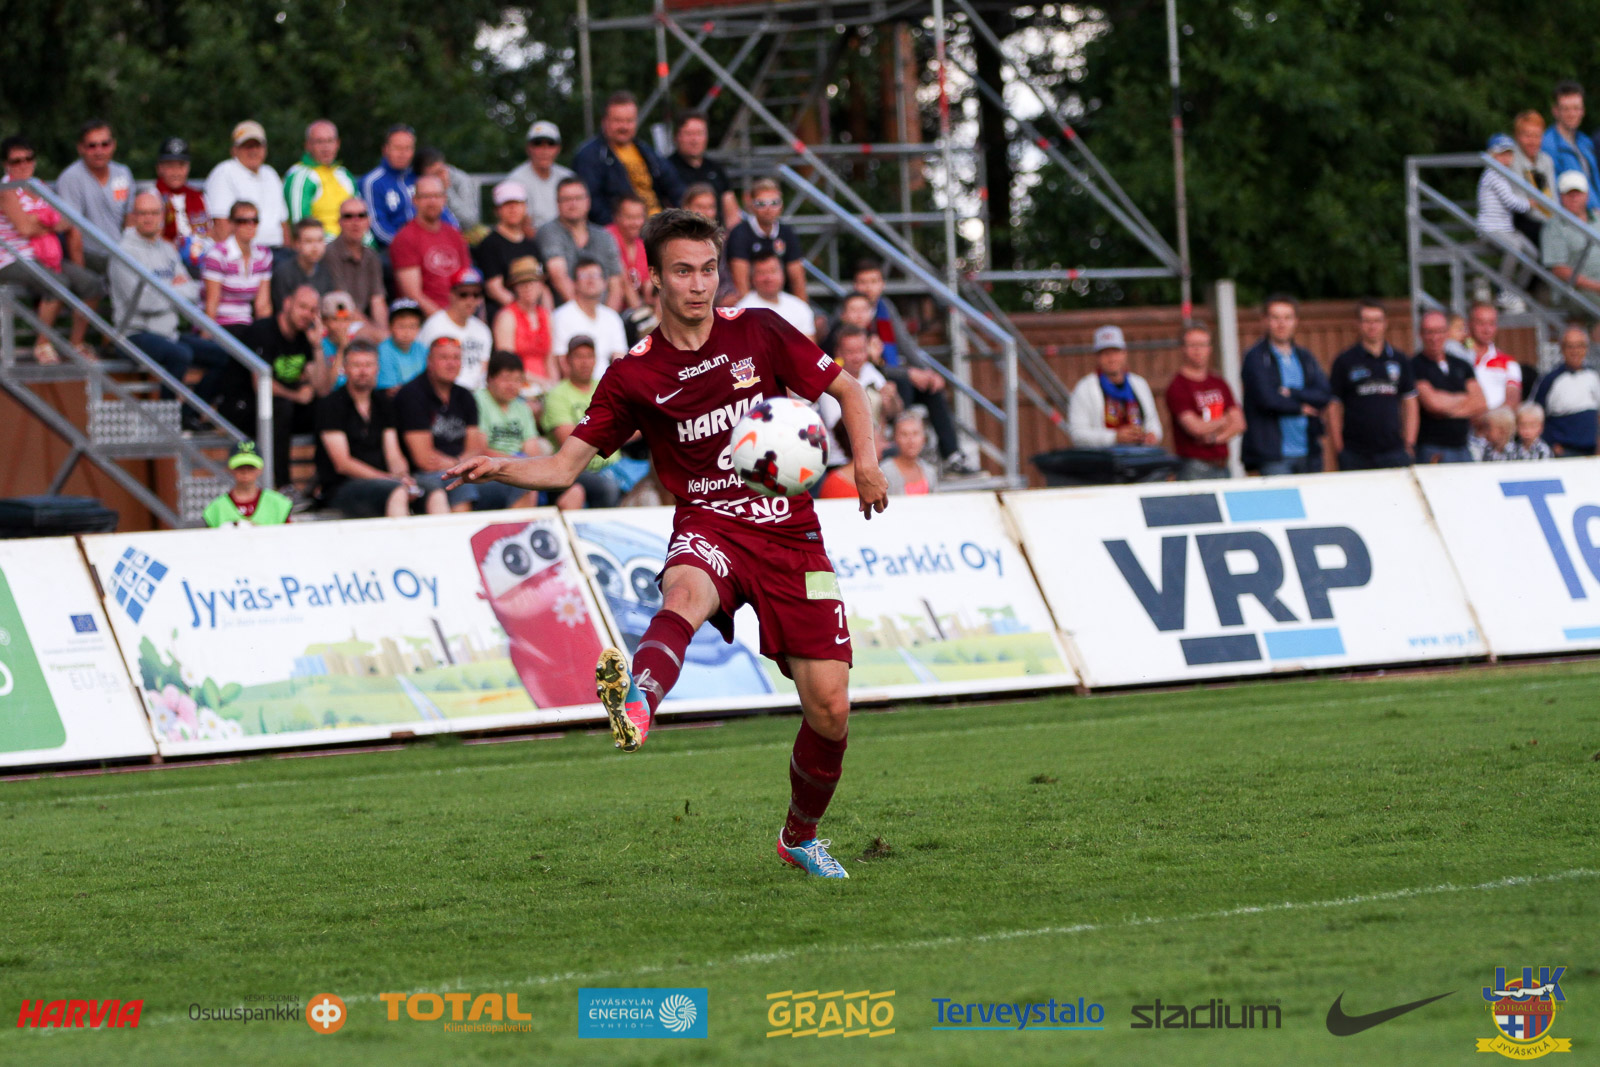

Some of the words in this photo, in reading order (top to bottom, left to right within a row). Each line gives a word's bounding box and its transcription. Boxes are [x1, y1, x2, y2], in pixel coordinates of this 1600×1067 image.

[678, 353, 730, 381] stadium
[960, 541, 1004, 577] Oy
[1102, 526, 1372, 632] VRP
[182, 571, 385, 628] Jyväs-Parkki
[393, 568, 438, 607] Oy
